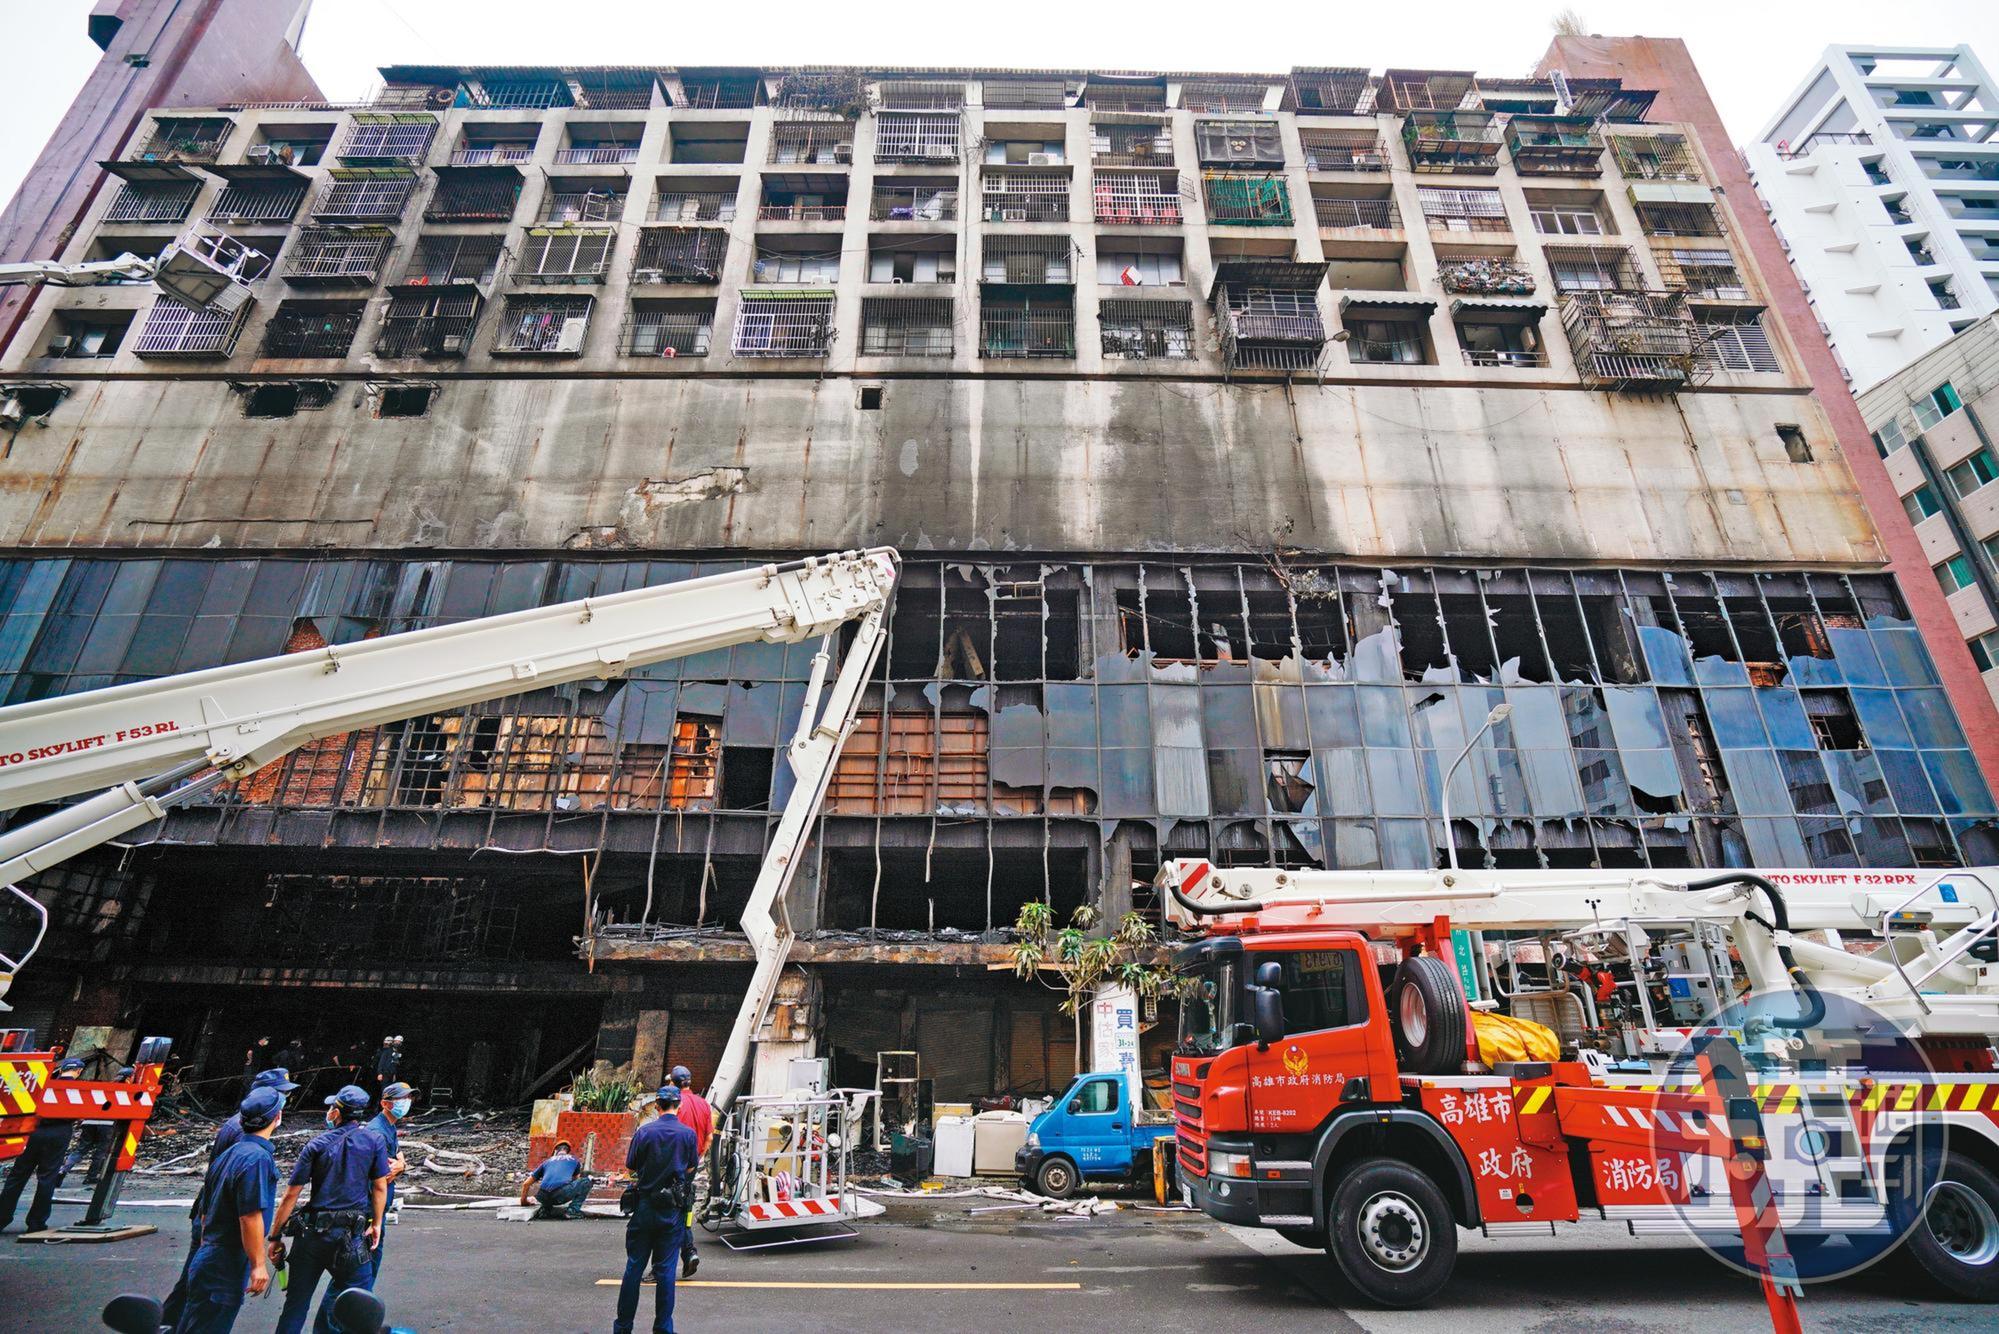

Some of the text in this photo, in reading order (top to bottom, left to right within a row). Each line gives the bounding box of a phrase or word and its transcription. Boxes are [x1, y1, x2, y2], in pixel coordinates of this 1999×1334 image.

[28, 735, 105, 760] SKYLIFT
[115, 731, 127, 742] F
[129, 726, 153, 739] 53
[154, 720, 179, 734] RL
[1793, 874, 1848, 885] SKYLIFT
[1854, 875, 1862, 885] F
[1865, 875, 1883, 885] 32
[1252, 1072, 1345, 1088] 高雄市政府消防局
[1439, 1090, 1512, 1126] 高雄市
[1478, 1146, 1533, 1179] 政府
[1602, 1157, 1679, 1192] 消防局
